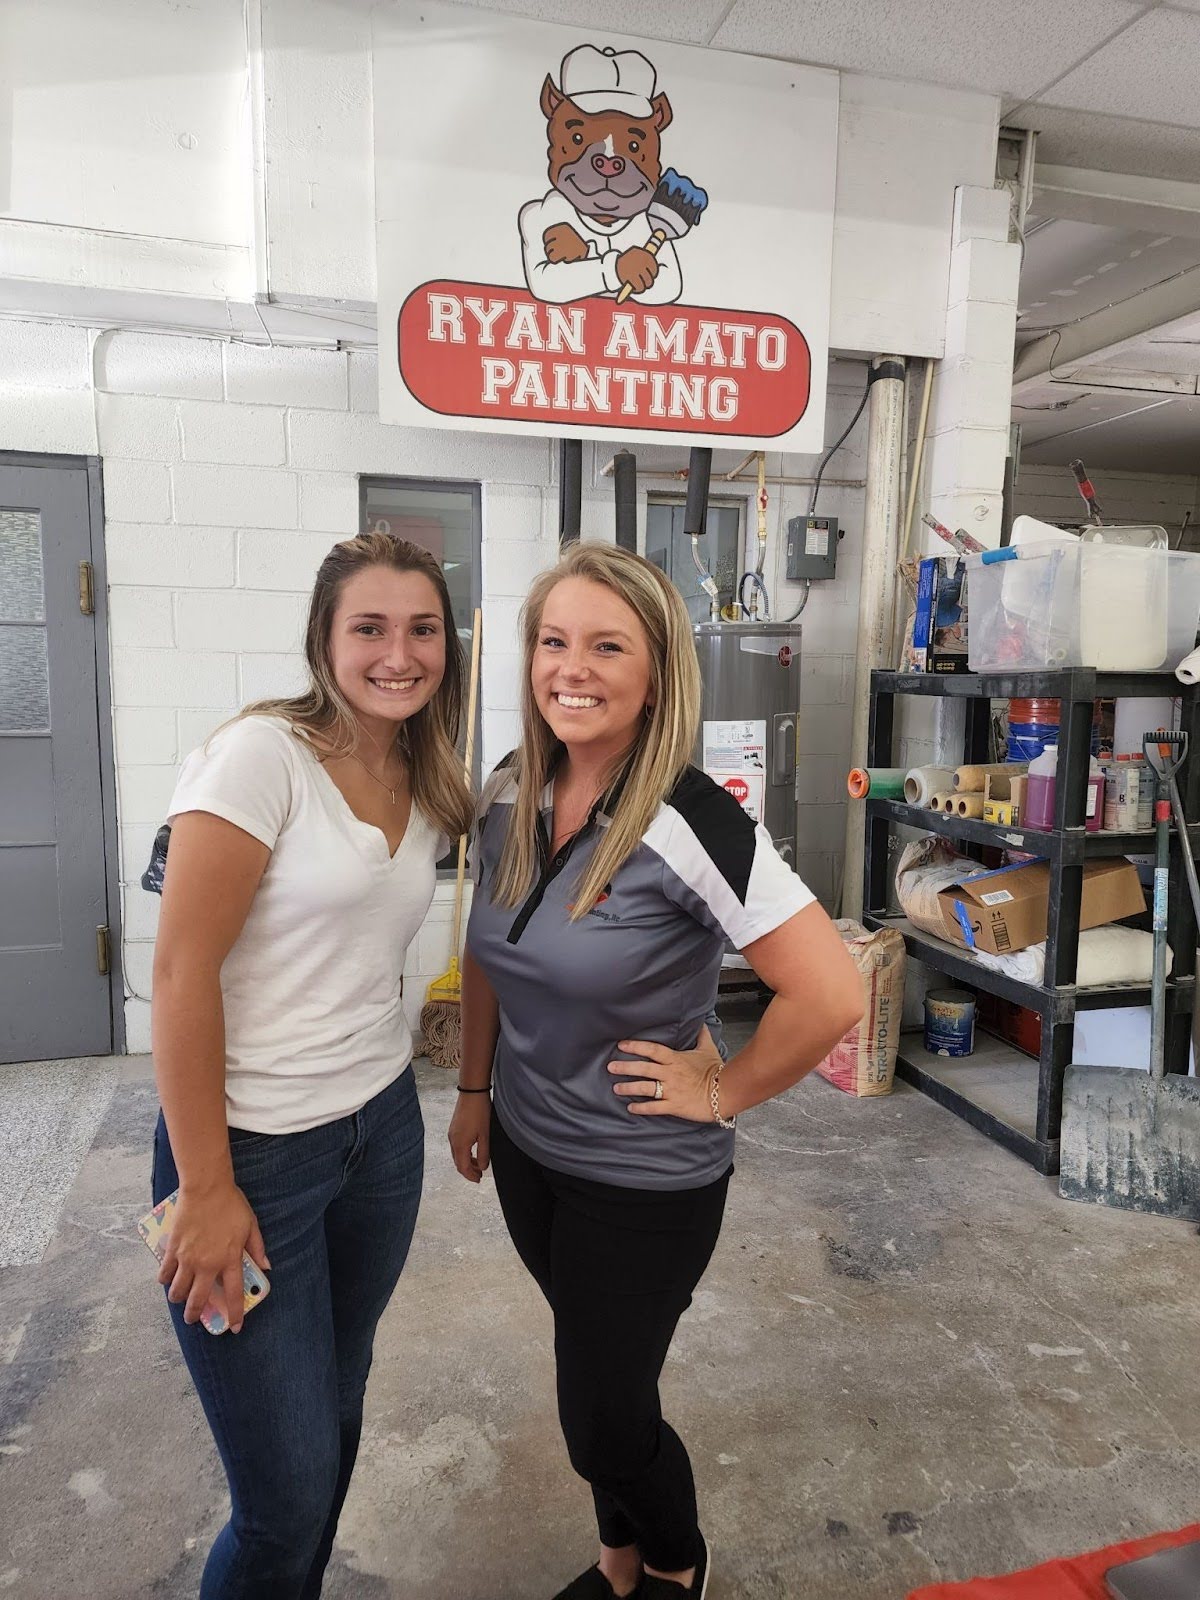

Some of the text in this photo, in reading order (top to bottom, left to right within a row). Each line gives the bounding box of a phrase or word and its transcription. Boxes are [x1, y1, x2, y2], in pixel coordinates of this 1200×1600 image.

[427, 292, 788, 372] RYAN AMATO
[480, 356, 739, 422] PAINTING
